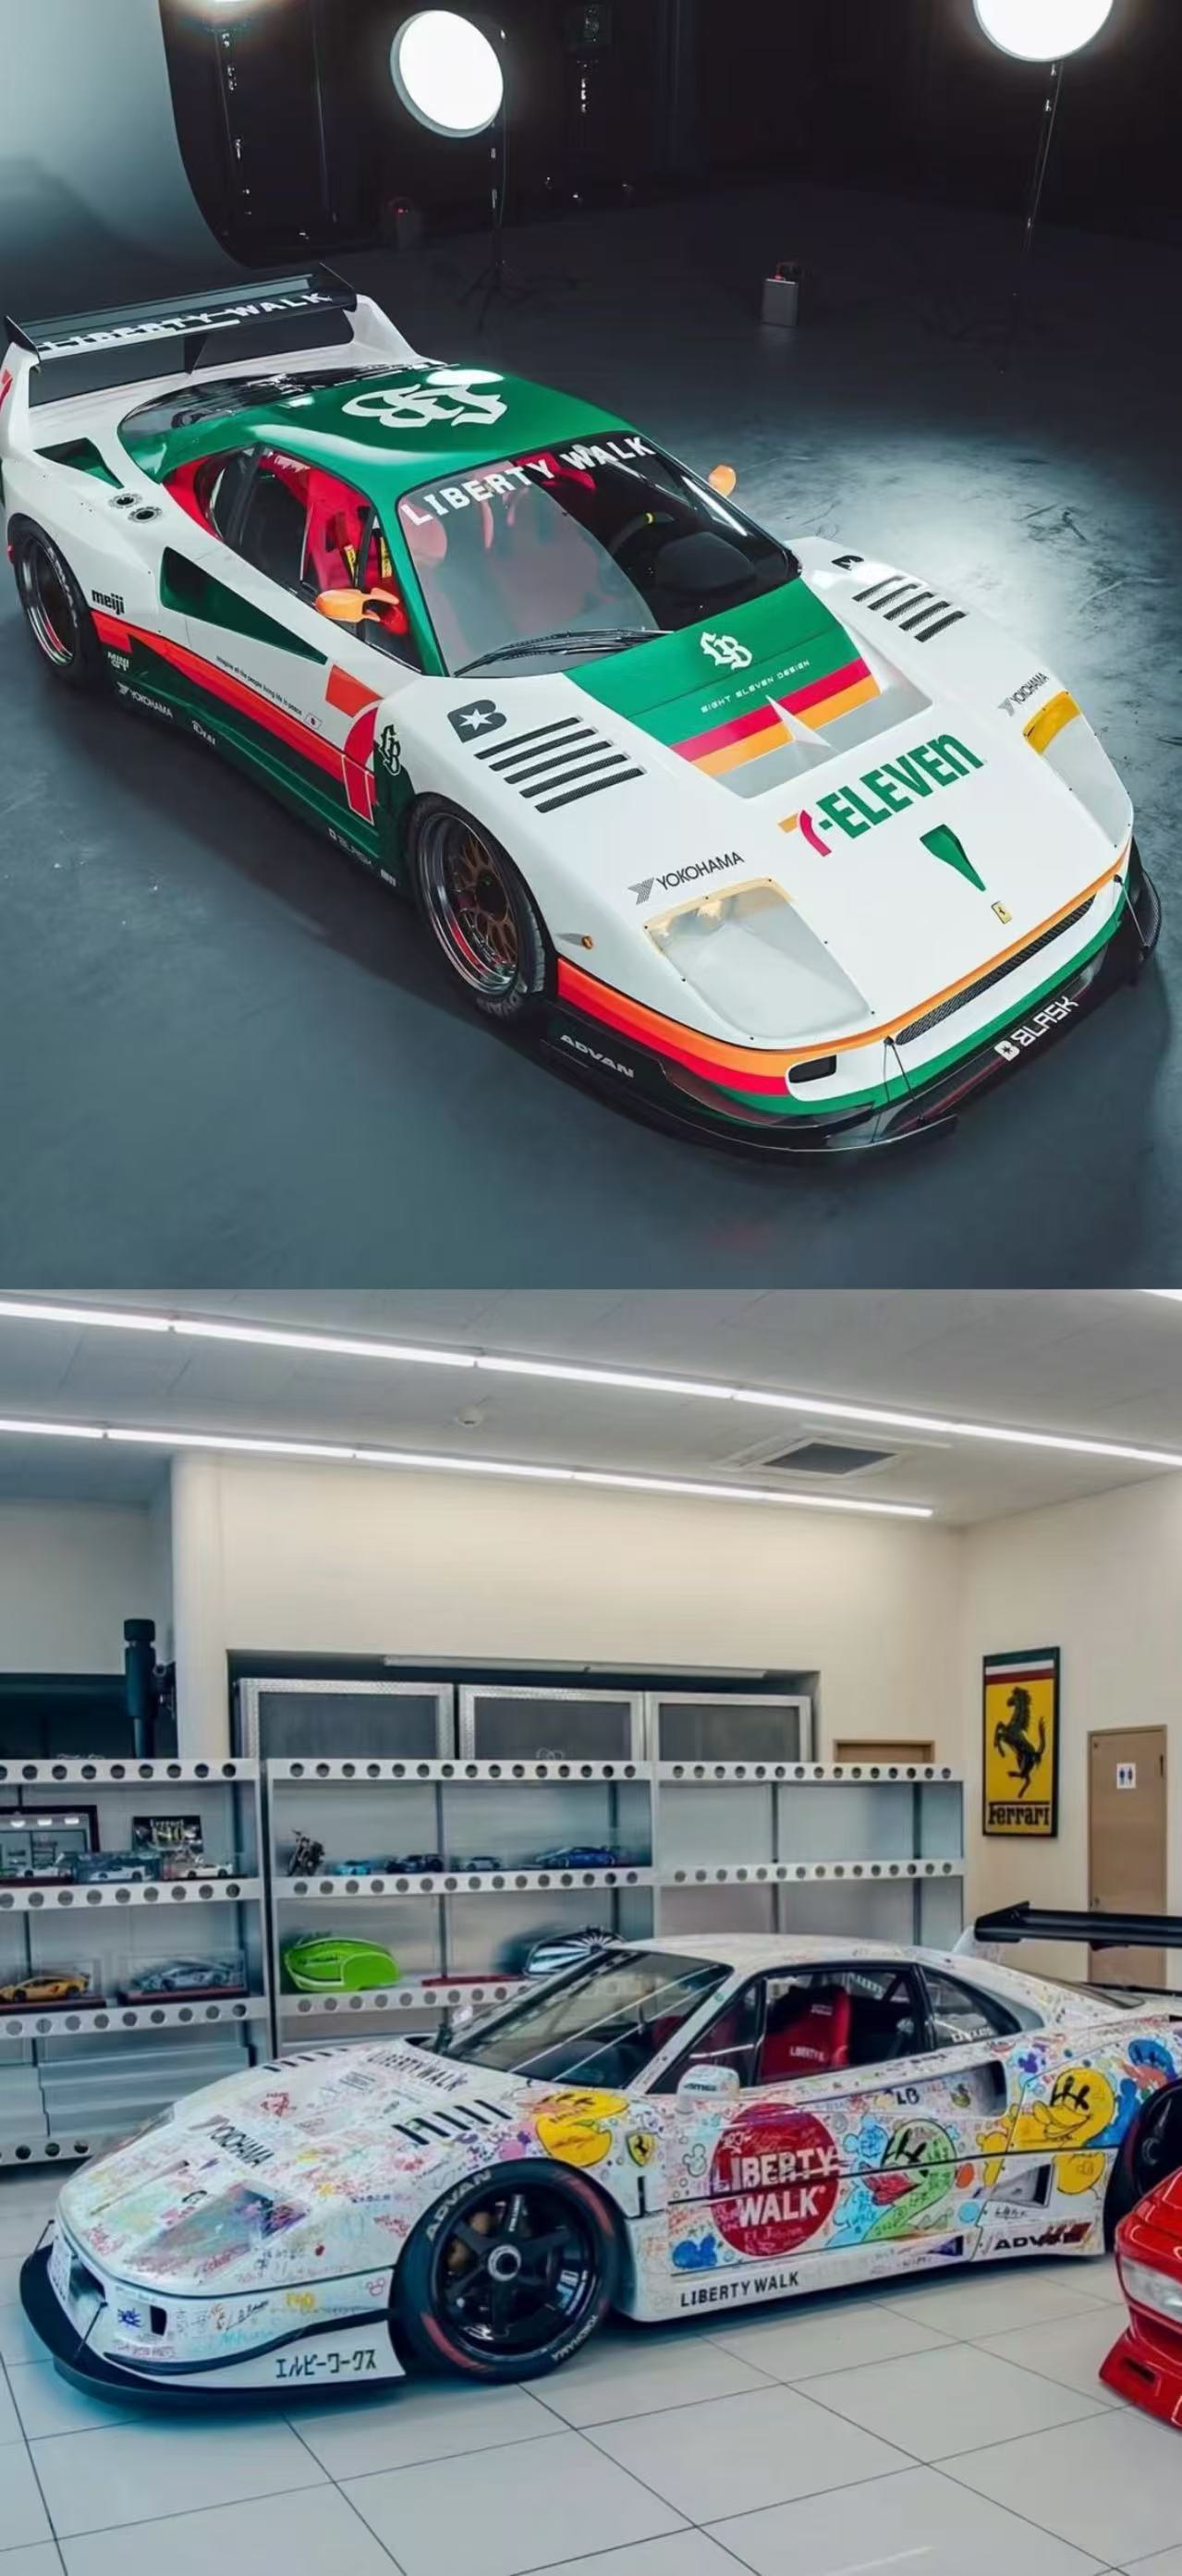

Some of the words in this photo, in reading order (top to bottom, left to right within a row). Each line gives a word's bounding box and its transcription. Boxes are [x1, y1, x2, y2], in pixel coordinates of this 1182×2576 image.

[226, 292, 333, 318] WALK
[401, 458, 554, 526] LIBERTY
[559, 436, 657, 471] WALK
[91, 589, 126, 617] meiji
[735, 677, 774, 698] ELEVEN
[1009, 672, 1050, 705] YOKOHAMA
[655, 851, 745, 890] YOKOHAMA
[560, 1034, 635, 1079] ADVAN
[988, 1801, 1050, 1825] Ferrari
[367, 2051, 419, 2074] LIBERTY
[416, 2061, 463, 2092] WALK
[896, 2087, 920, 2106] LB
[208, 2122, 275, 2168] YOKOHAMA
[714, 2146, 839, 2192] LIBERTY
[426, 2169, 494, 2242] ADVAN
[680, 2279, 749, 2307] LIBERTY
[754, 2270, 799, 2294] WALK
